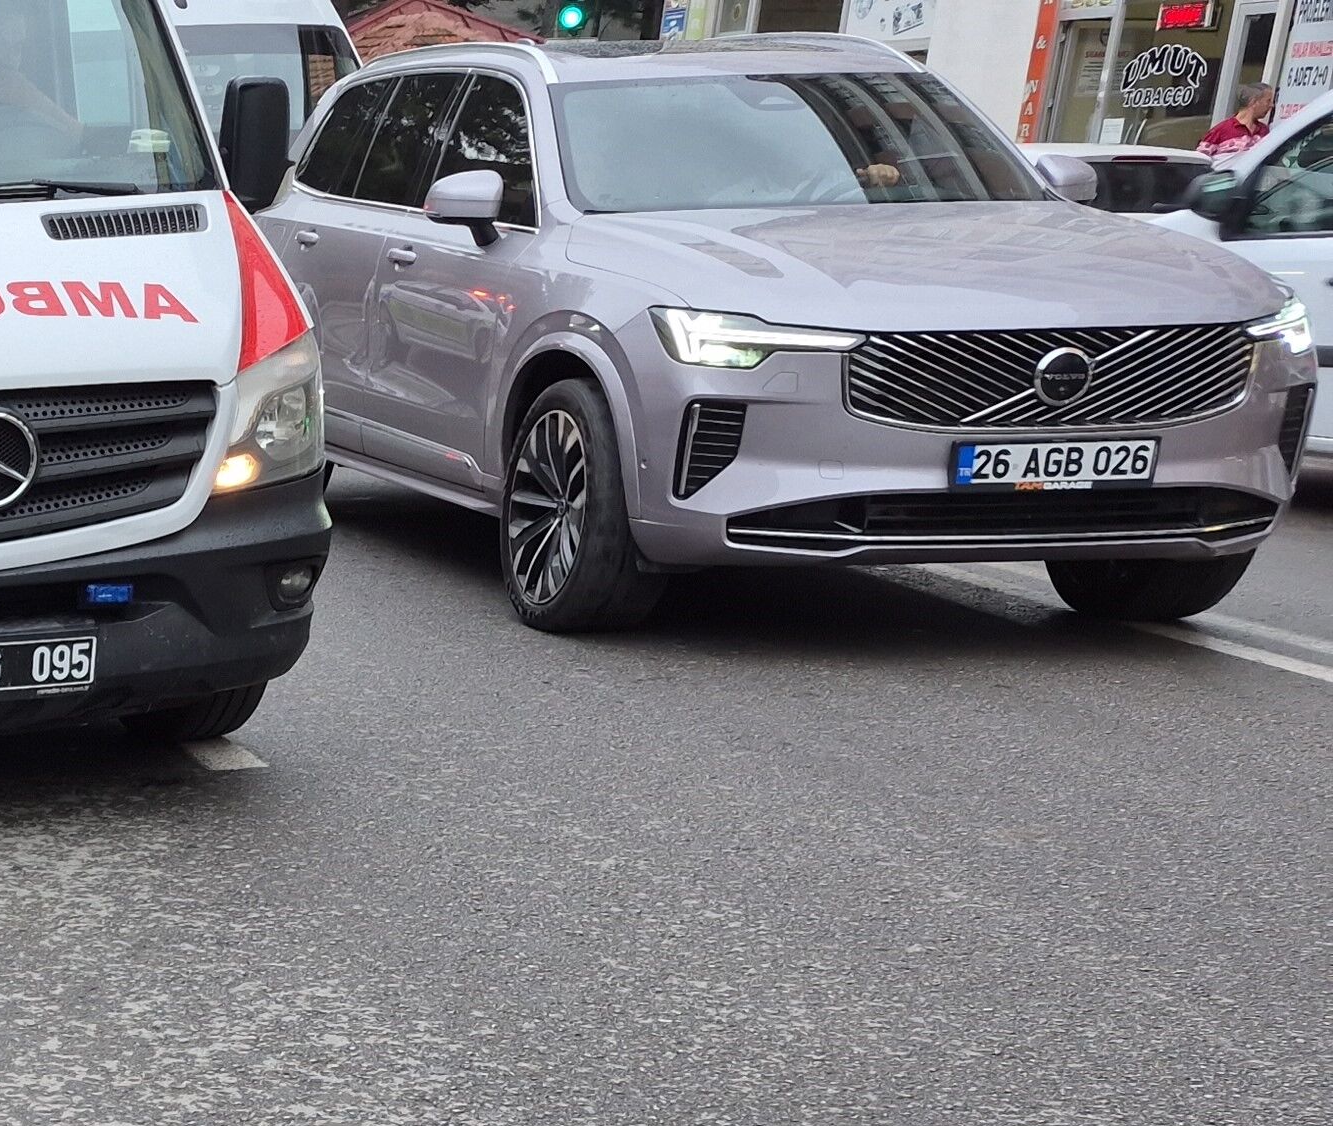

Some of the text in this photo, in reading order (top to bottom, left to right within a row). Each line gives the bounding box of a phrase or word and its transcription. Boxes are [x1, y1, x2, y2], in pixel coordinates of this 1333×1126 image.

[1036, 35, 1047, 49] &
[1120, 44, 1208, 91] UMUT
[1123, 85, 1194, 107] TOBACCO
[972, 449, 1011, 479] 26
[1022, 447, 1084, 478] AGB
[1093, 445, 1150, 476] 026
[32, 643, 90, 683] 095
